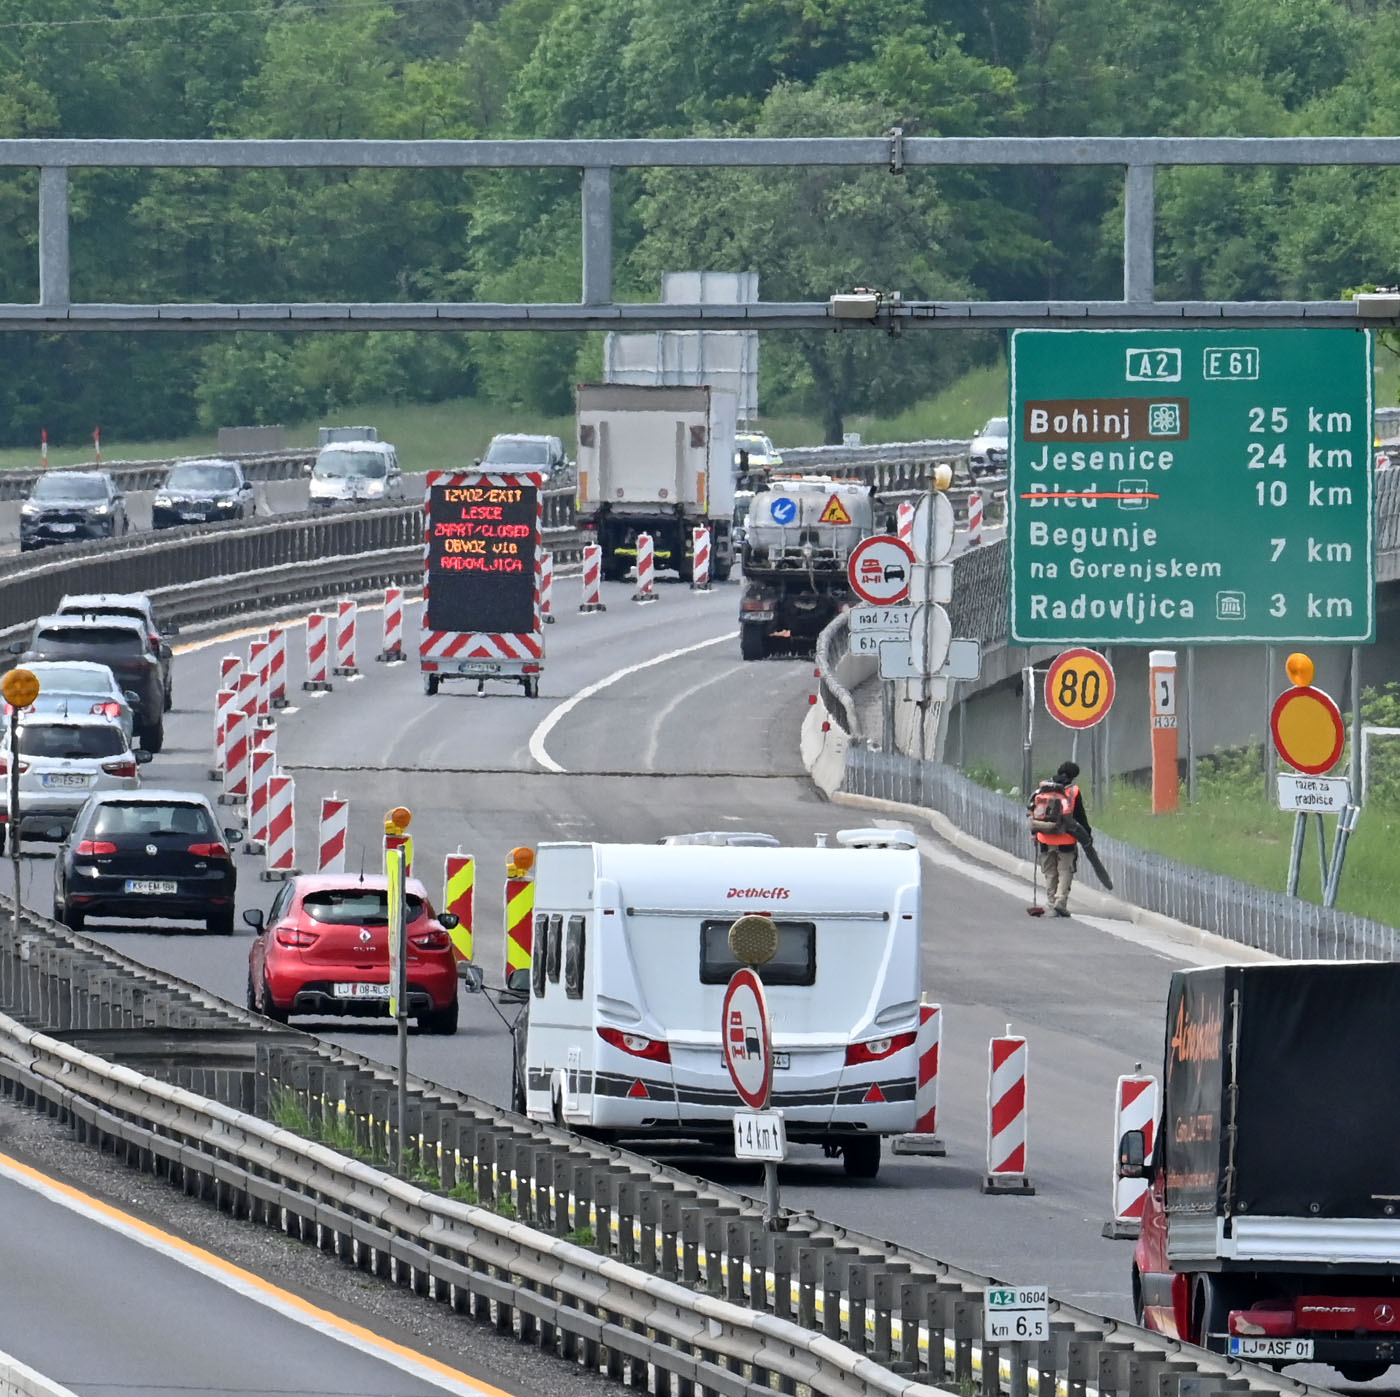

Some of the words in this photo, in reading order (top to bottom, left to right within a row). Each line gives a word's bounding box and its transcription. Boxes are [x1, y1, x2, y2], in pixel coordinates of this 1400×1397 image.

[1139, 354, 1168, 376] A2
[1210, 354, 1221, 374] E
[1230, 354, 1253, 374] 61
[1030, 408, 1130, 438] Bohinj
[1248, 407, 1288, 433] 25
[1308, 407, 1352, 433] km
[1030, 446, 1174, 471] Jesenice
[1247, 443, 1287, 469] 24
[1308, 443, 1352, 468] km
[1030, 483, 1098, 508] Bled
[1256, 481, 1287, 507] 10
[1308, 480, 1352, 506] km
[461, 506, 503, 520] LESCE
[445, 539, 486, 554] OBVOZ
[1030, 522, 1157, 552] Begunje
[1270, 538, 1286, 562] 7
[1308, 538, 1352, 562] km
[441, 556, 523, 572] RADOVLJICA
[1031, 562, 1058, 578] na
[1070, 558, 1222, 582] Gorenjskem
[860, 612, 877, 624] nad
[1031, 594, 1194, 624] Radovljica
[1269, 594, 1287, 618] 3
[1308, 595, 1352, 618] km
[1058, 669, 1100, 708] 80
[726, 887, 790, 899] Dethleffs
[746, 1120, 753, 1150] 4
[756, 1120, 771, 1150] km
[993, 1292, 1012, 1304] A2
[1020, 1292, 1046, 1304] 0604
[992, 1323, 1009, 1336] km
[1243, 1341, 1258, 1353] LJ
[1267, 1342, 1292, 1355] ASF
[1296, 1342, 1309, 1356] 01
